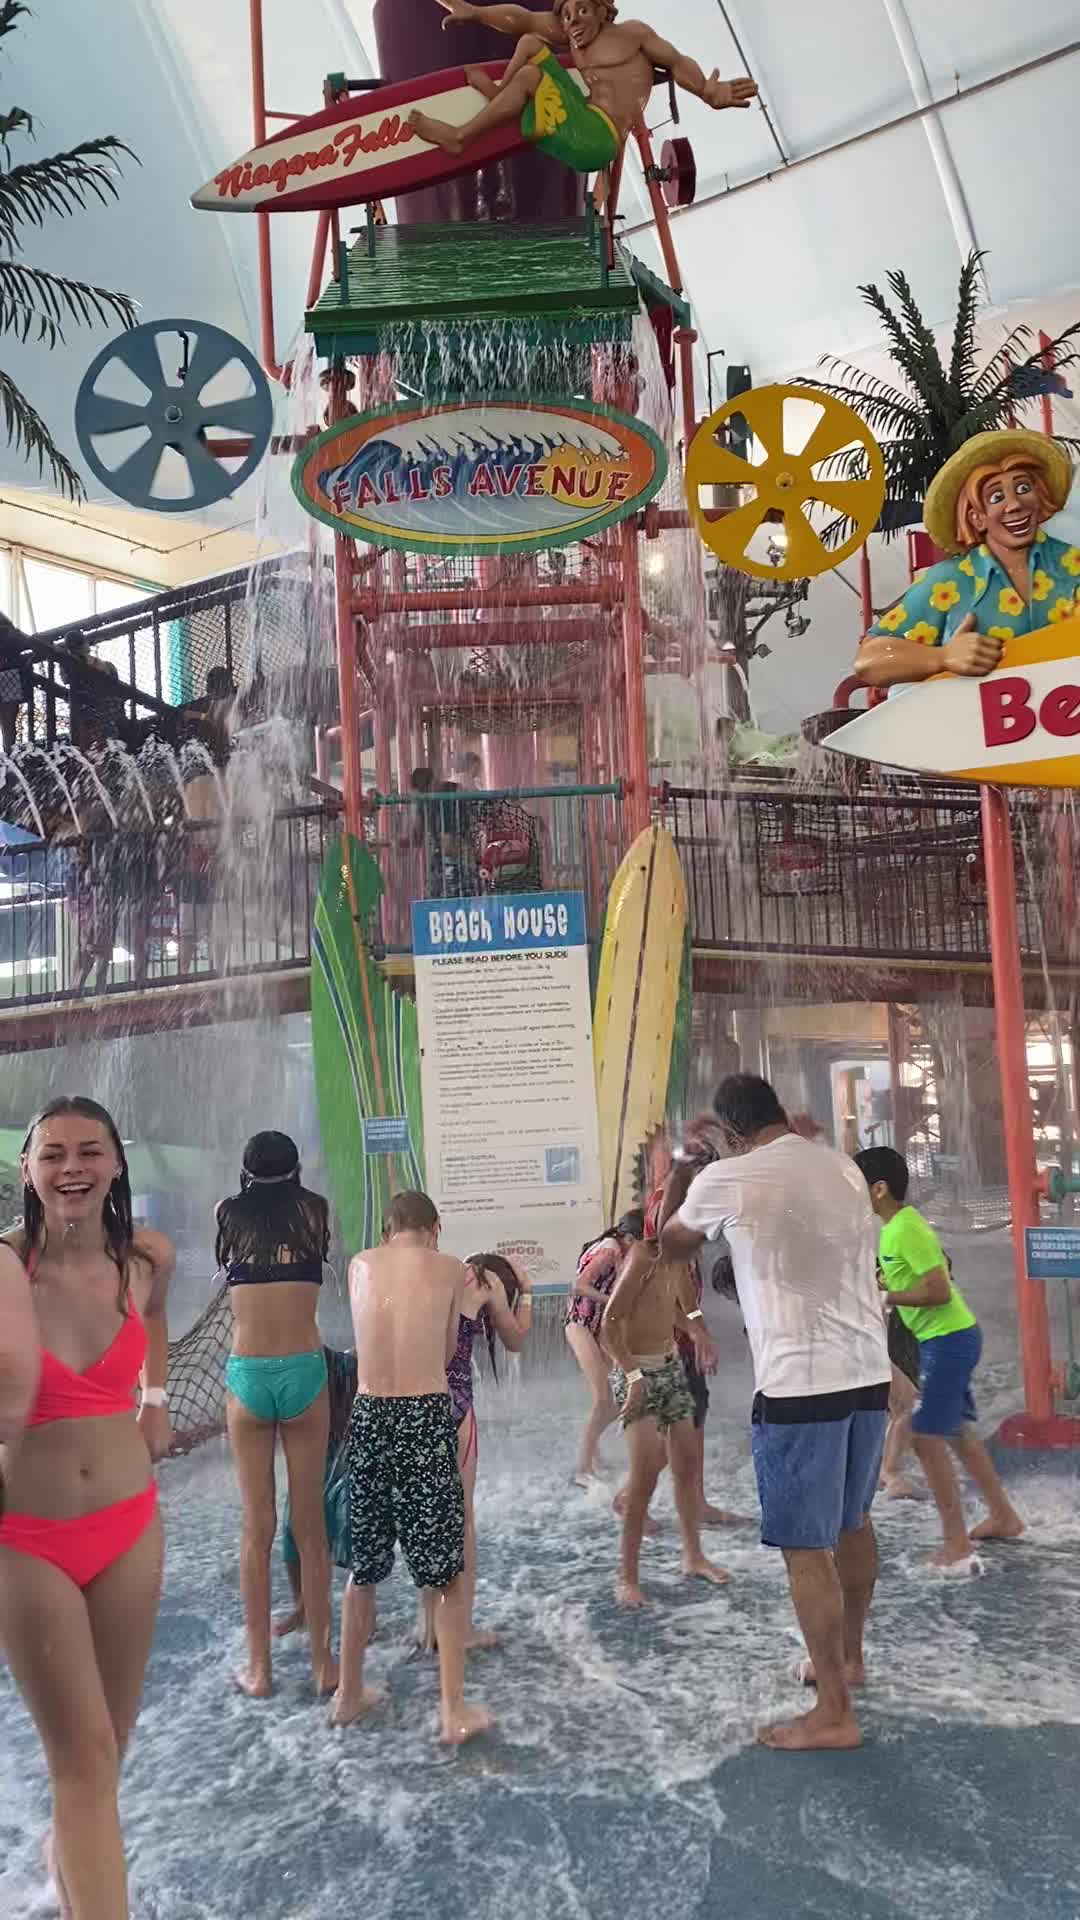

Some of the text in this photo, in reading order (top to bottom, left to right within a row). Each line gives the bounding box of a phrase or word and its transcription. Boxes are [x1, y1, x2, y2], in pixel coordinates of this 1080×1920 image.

[214, 115, 416, 197] Niagara Falls
[330, 463, 634, 517] FALLS AVENUE
[432, 950, 568, 967] PLEASE READ BEFORE YOU SLIDE
